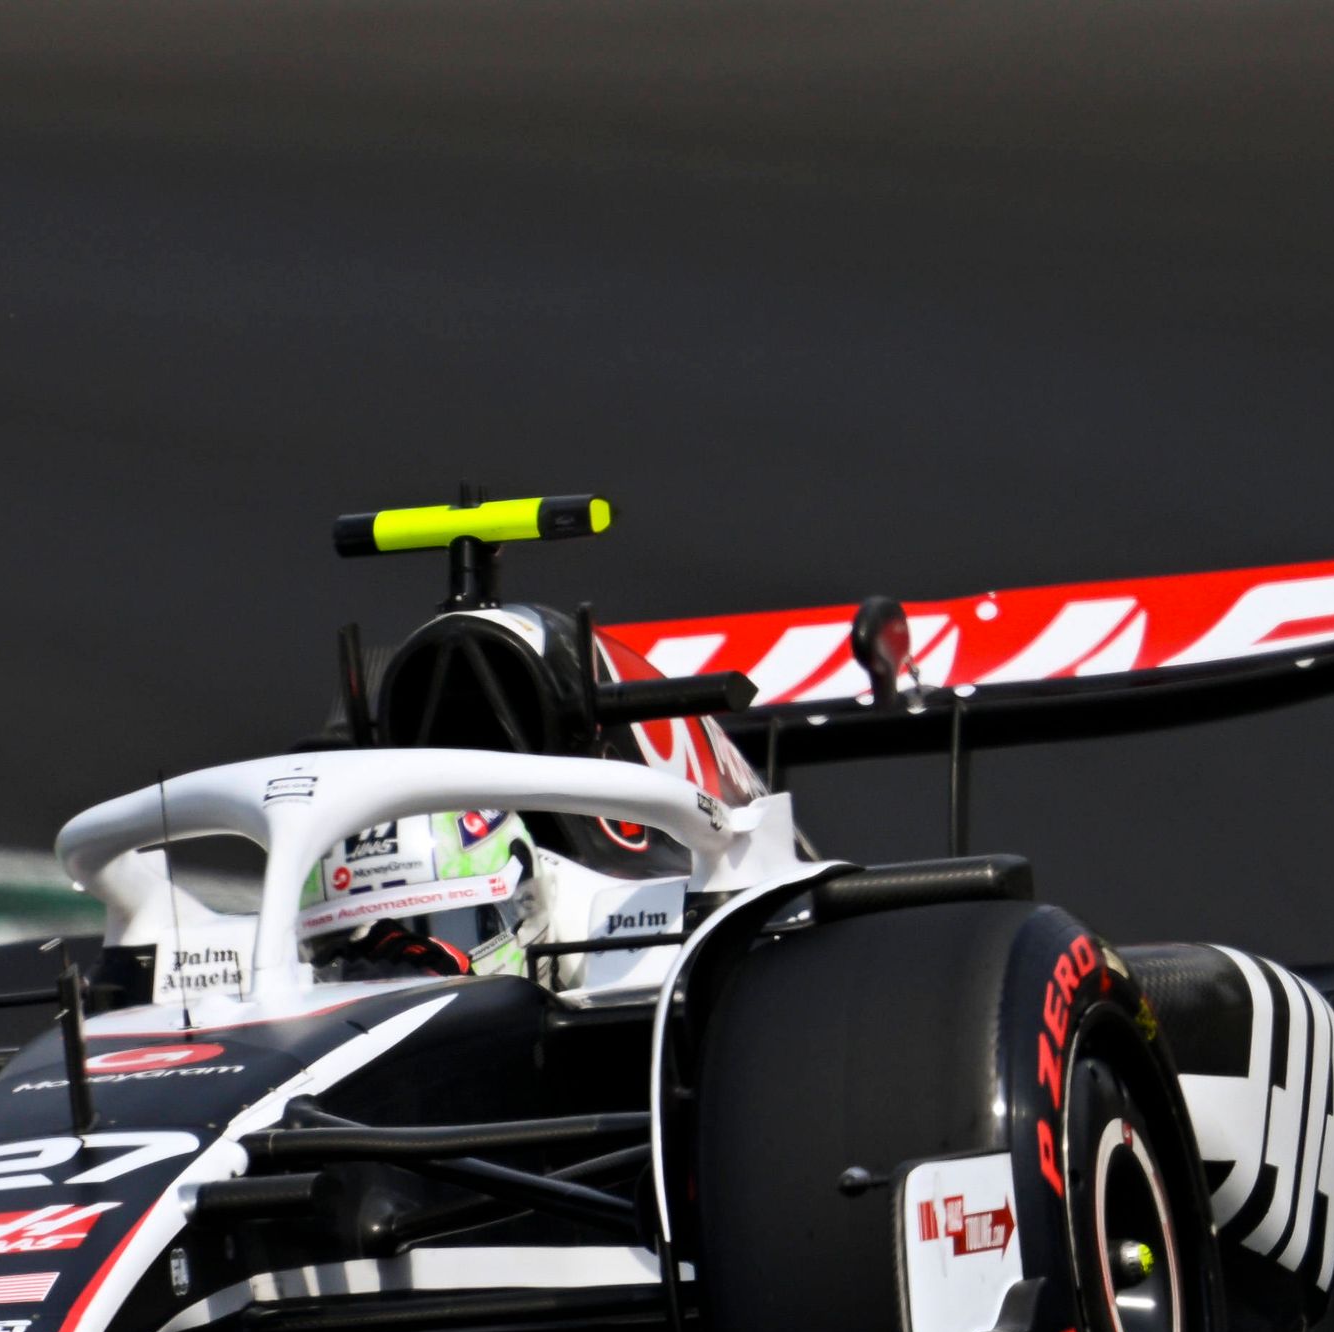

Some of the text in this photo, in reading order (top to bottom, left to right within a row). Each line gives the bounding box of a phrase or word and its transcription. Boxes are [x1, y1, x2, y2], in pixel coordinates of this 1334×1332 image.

[338, 890, 444, 920] Automation
[172, 948, 234, 971] Palm
[12, 1064, 244, 1094] MoeyGram
[1037, 934, 1097, 1197] P ZERO
